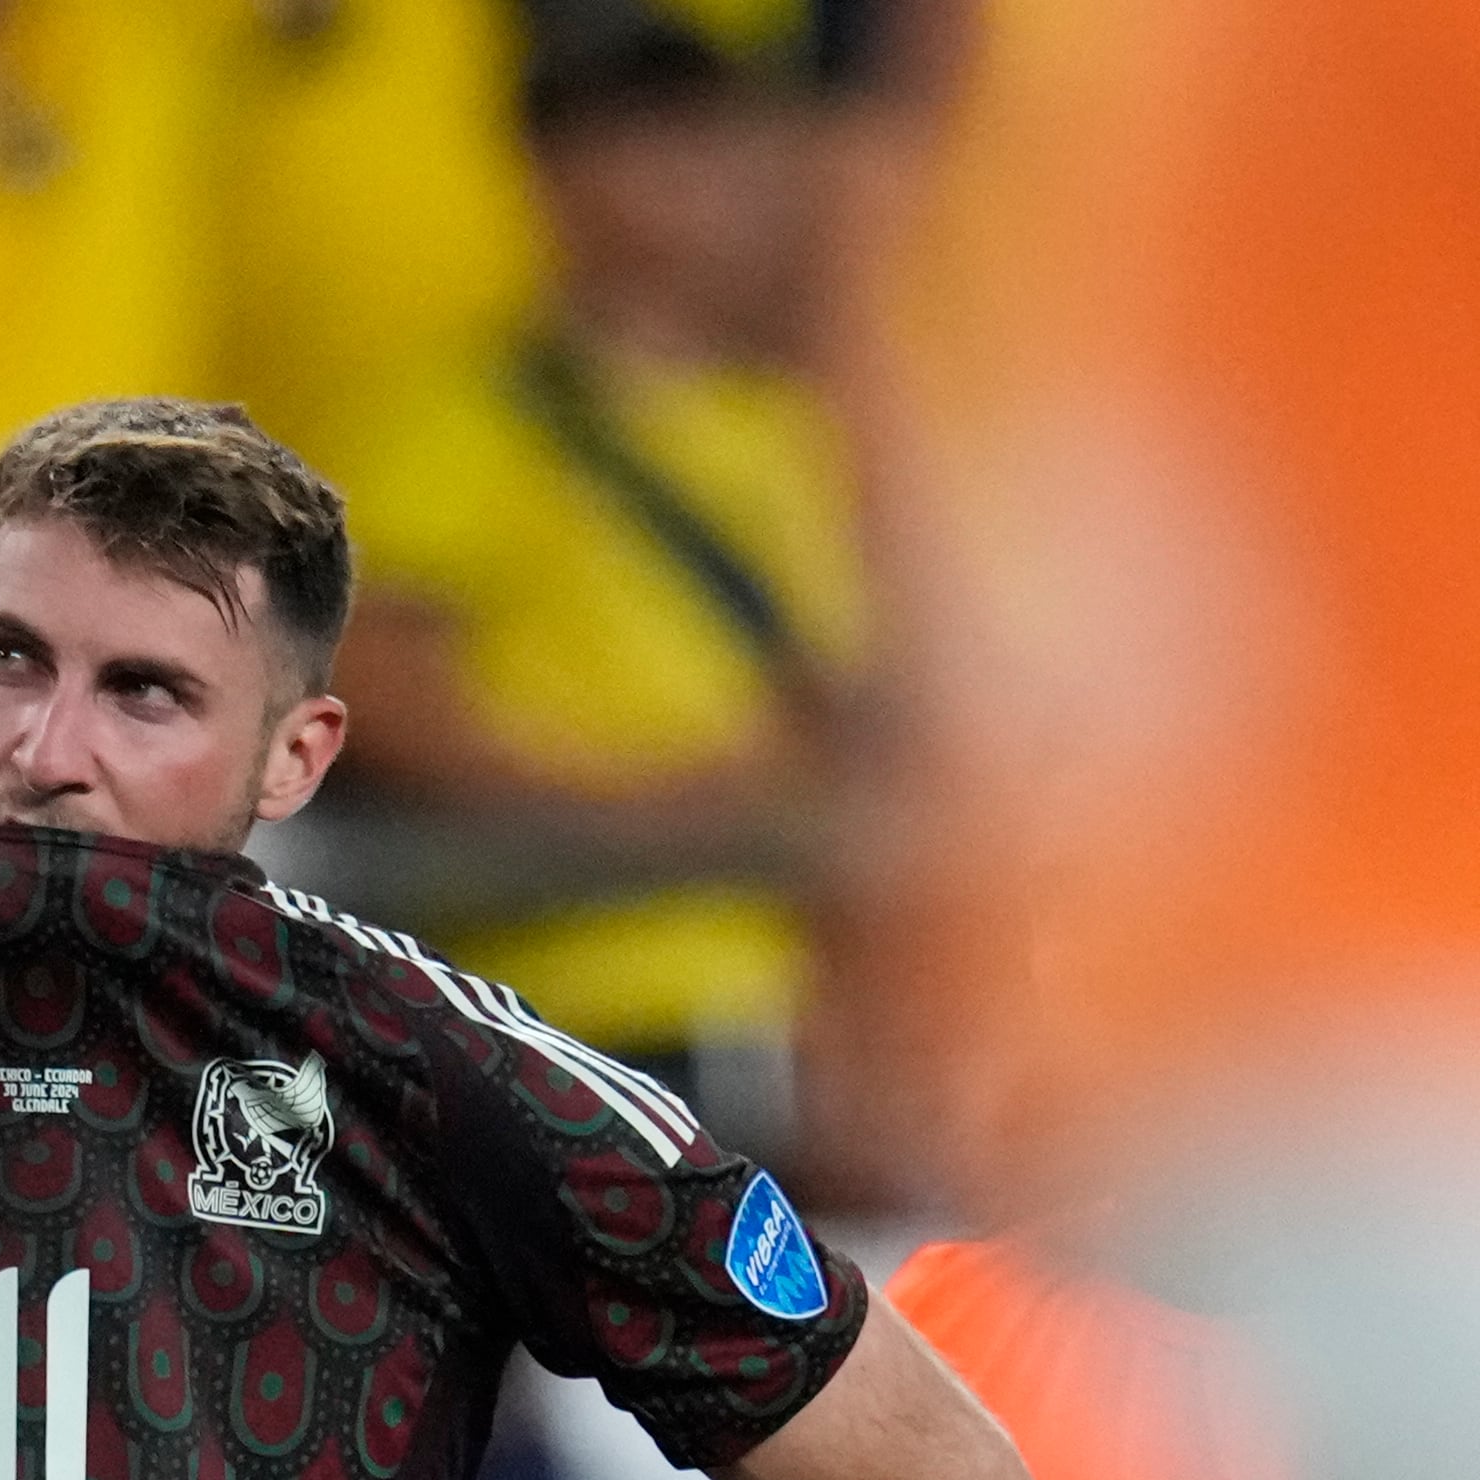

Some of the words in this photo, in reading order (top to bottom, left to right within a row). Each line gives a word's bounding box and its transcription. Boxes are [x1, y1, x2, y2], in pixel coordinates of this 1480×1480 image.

[44, 1068, 93, 1084] ECUADOR
[3, 1083, 17, 1096] 30
[20, 1083, 48, 1097] JUNE
[50, 1084, 79, 1098] 2024
[12, 1098, 69, 1113] GLENDALE
[746, 1200, 786, 1287] VIBRA
